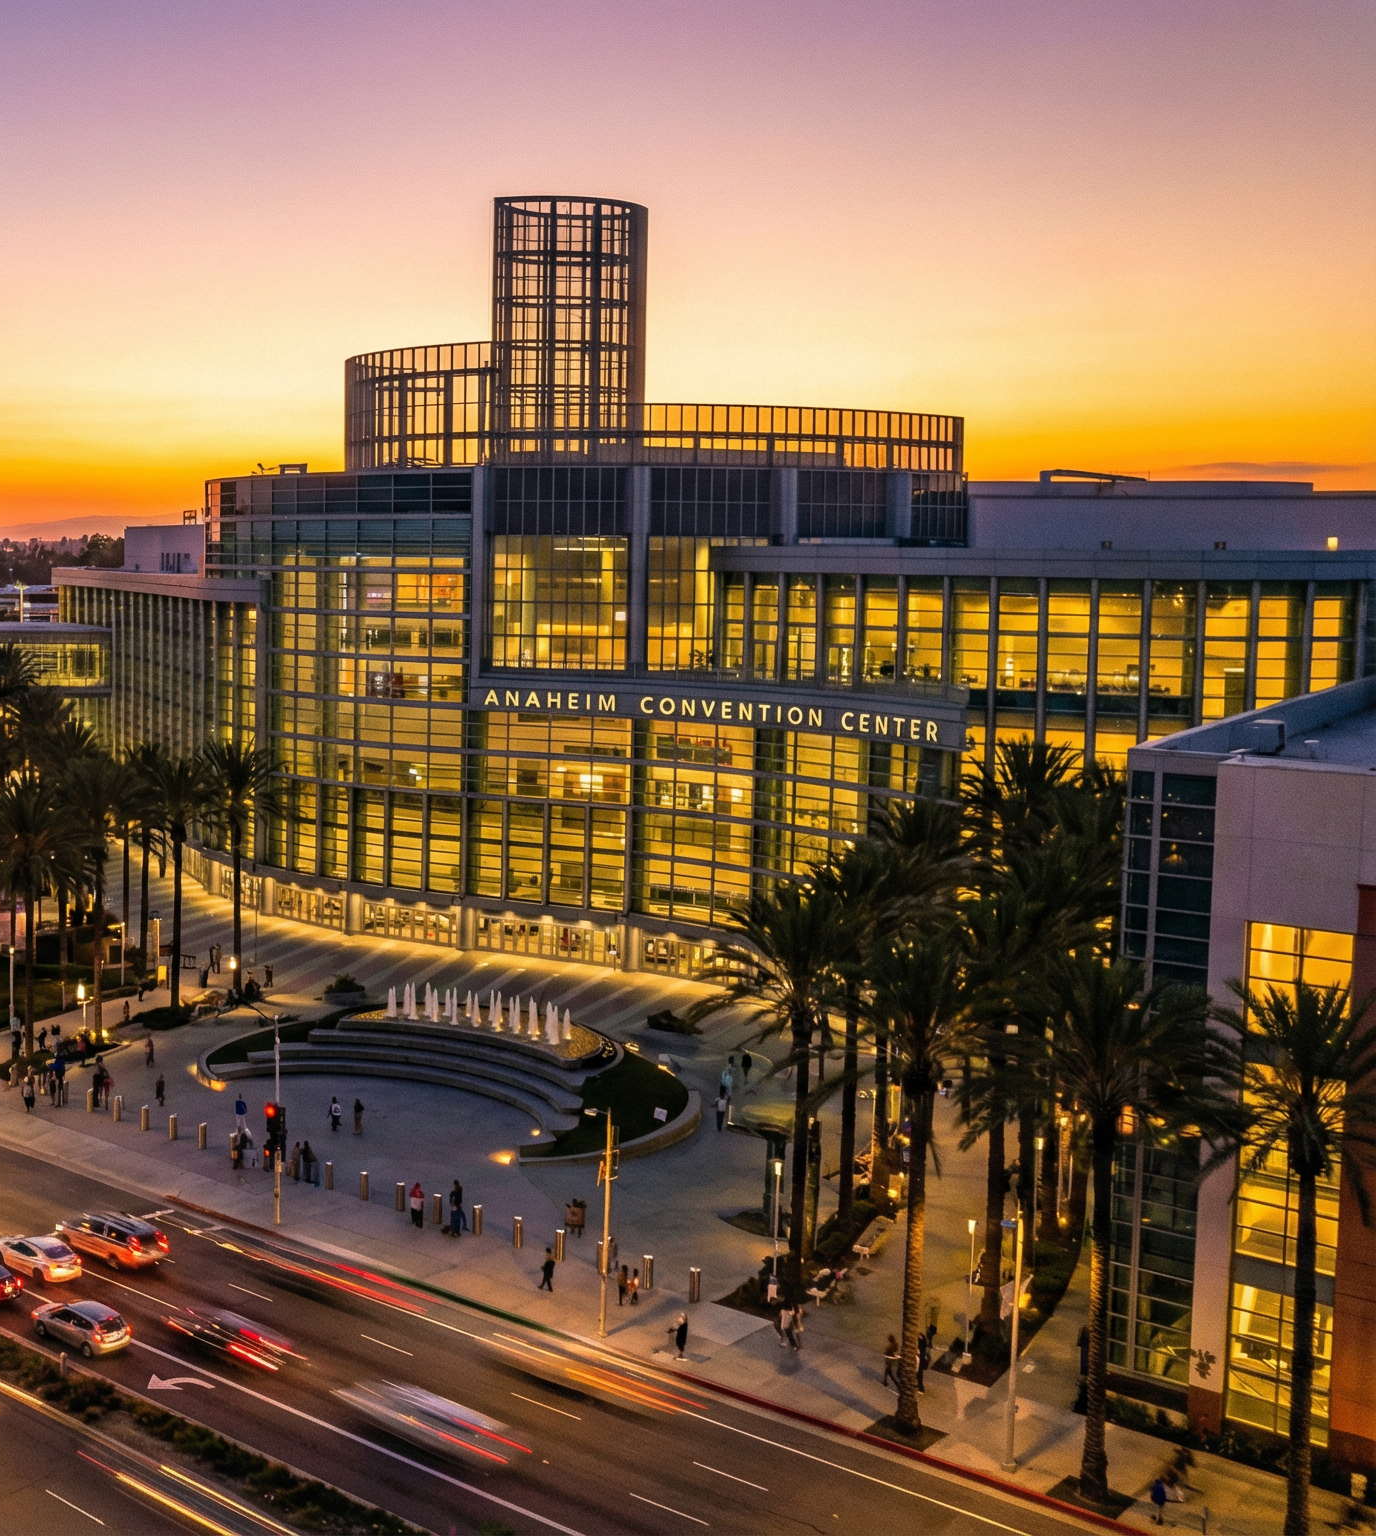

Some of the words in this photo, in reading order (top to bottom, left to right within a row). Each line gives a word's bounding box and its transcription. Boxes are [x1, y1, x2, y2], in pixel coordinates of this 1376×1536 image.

[484, 689, 616, 712] ANAHEIM
[640, 696, 823, 727] CONVENTION
[841, 711, 939, 743] CENTER
